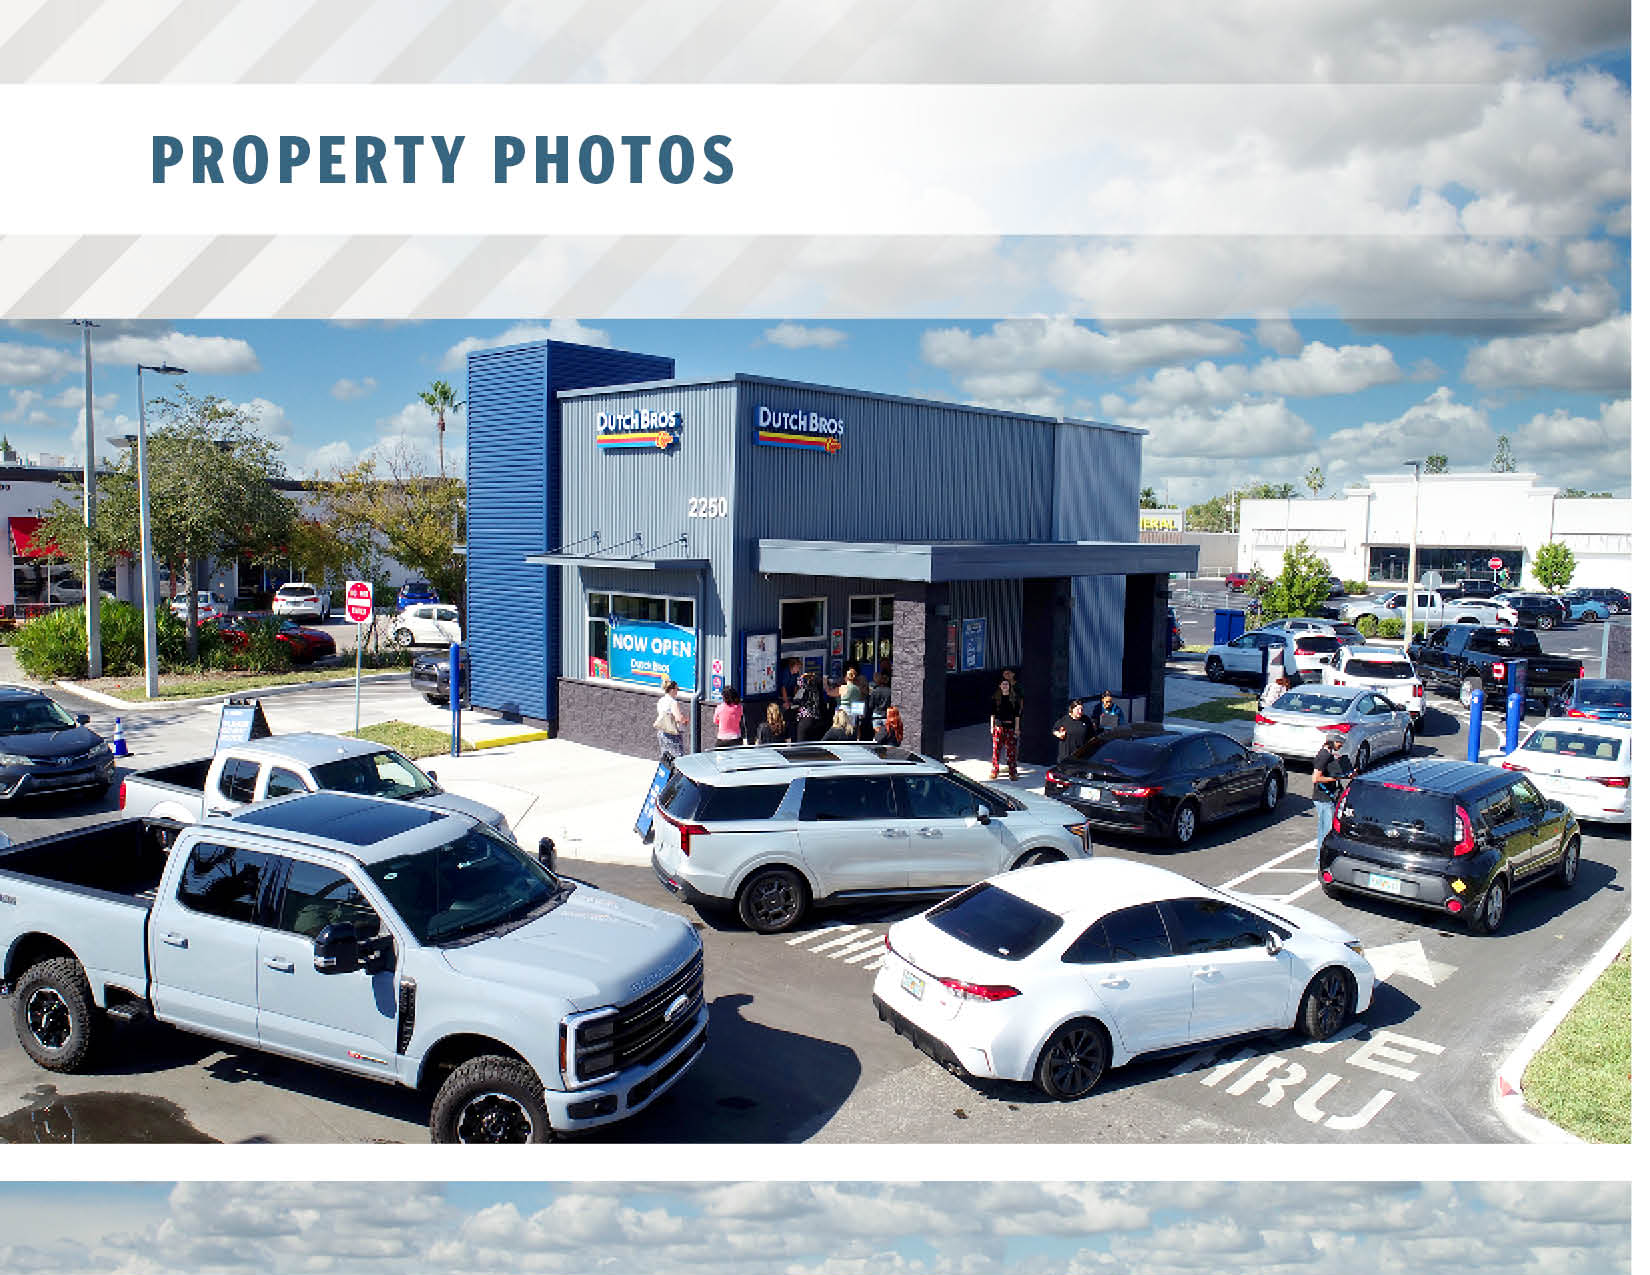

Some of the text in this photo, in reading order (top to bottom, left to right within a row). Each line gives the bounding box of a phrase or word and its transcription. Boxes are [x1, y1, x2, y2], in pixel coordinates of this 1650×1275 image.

[640, 409, 677, 428] BROS
[809, 412, 844, 435] BROS
[688, 496, 728, 518] 2250
[612, 633, 692, 658] NOW OPEN
